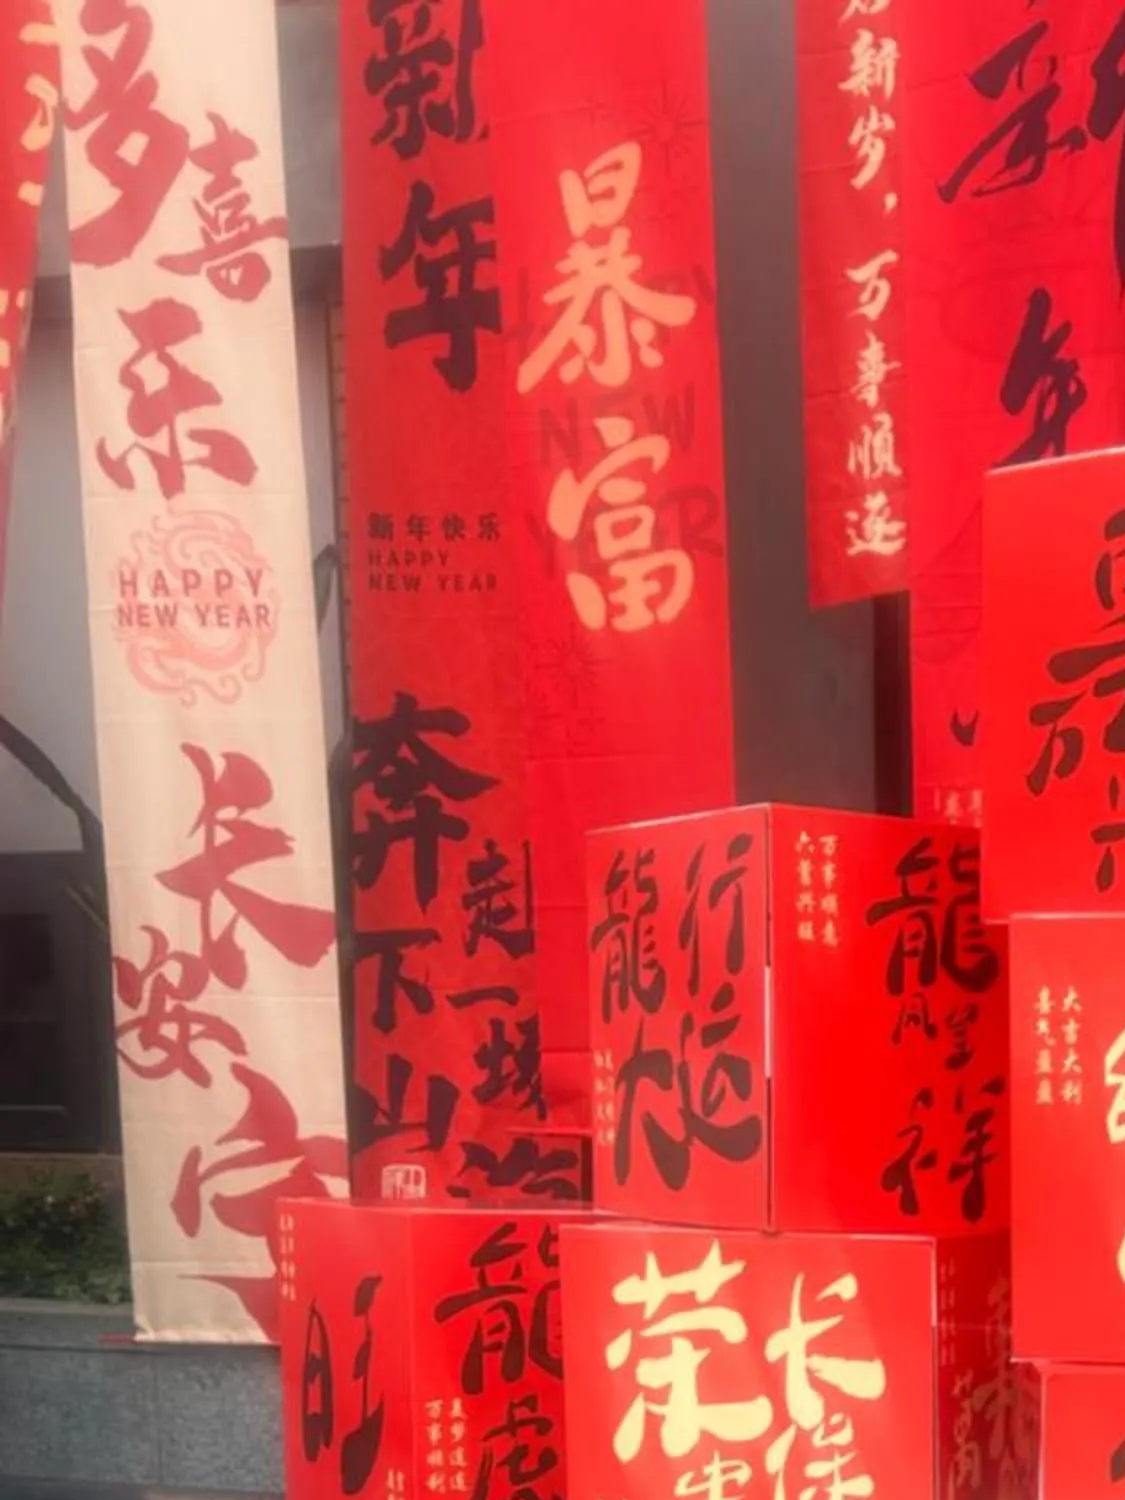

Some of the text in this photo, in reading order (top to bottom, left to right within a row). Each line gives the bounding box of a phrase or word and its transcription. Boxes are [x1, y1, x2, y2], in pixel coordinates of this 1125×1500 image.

[516, 141, 697, 633] 暴富
[367, 512, 500, 542] 新年快乐
[367, 550, 451, 567] HAPPY
[117, 566, 265, 599] HAPPY
[367, 573, 497, 592] NEW YEAR
[116, 601, 272, 630] NEW YEAR
[1061, 986, 1083, 1105] 大吉大利
